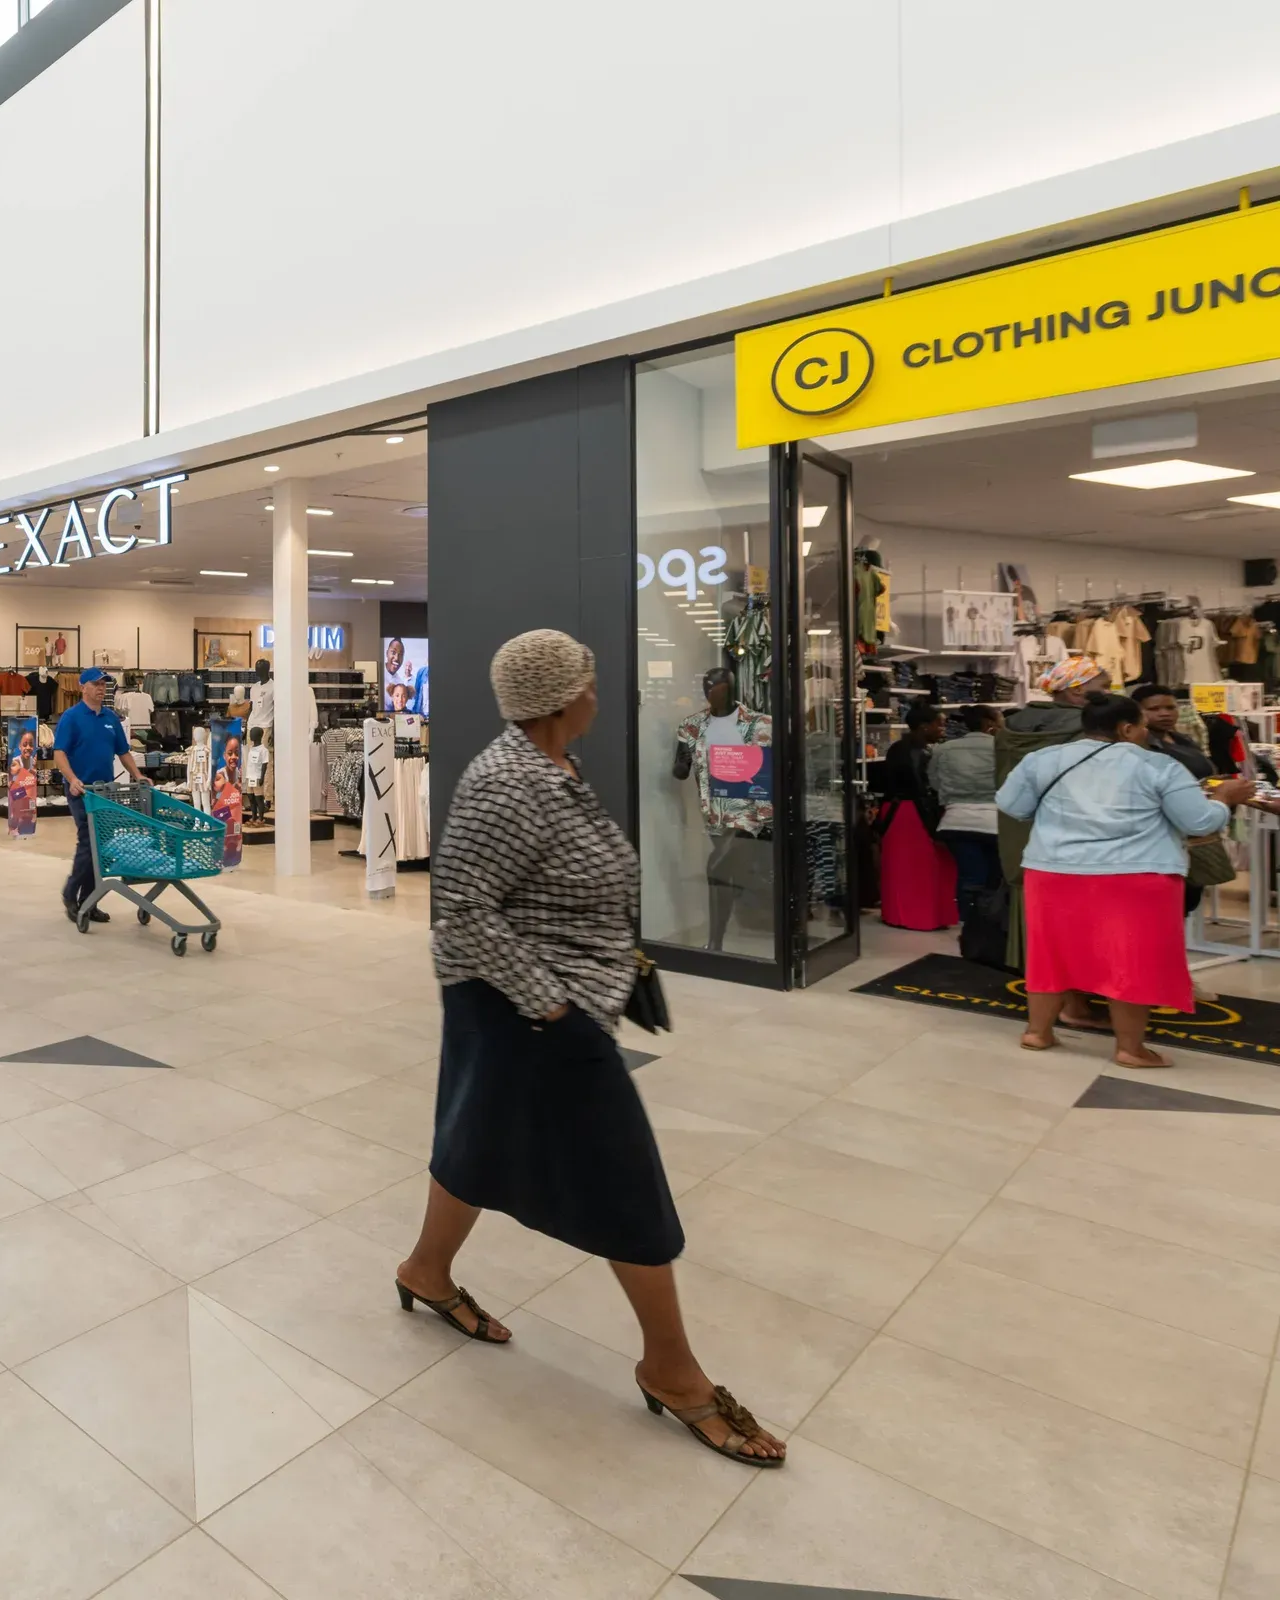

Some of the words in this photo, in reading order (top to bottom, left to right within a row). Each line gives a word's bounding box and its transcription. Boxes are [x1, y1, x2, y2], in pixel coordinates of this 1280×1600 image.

[902, 300, 1130, 368] CLOTHING
[794, 350, 849, 390] CJ
[894, 985, 1028, 1011] CLOTHI
